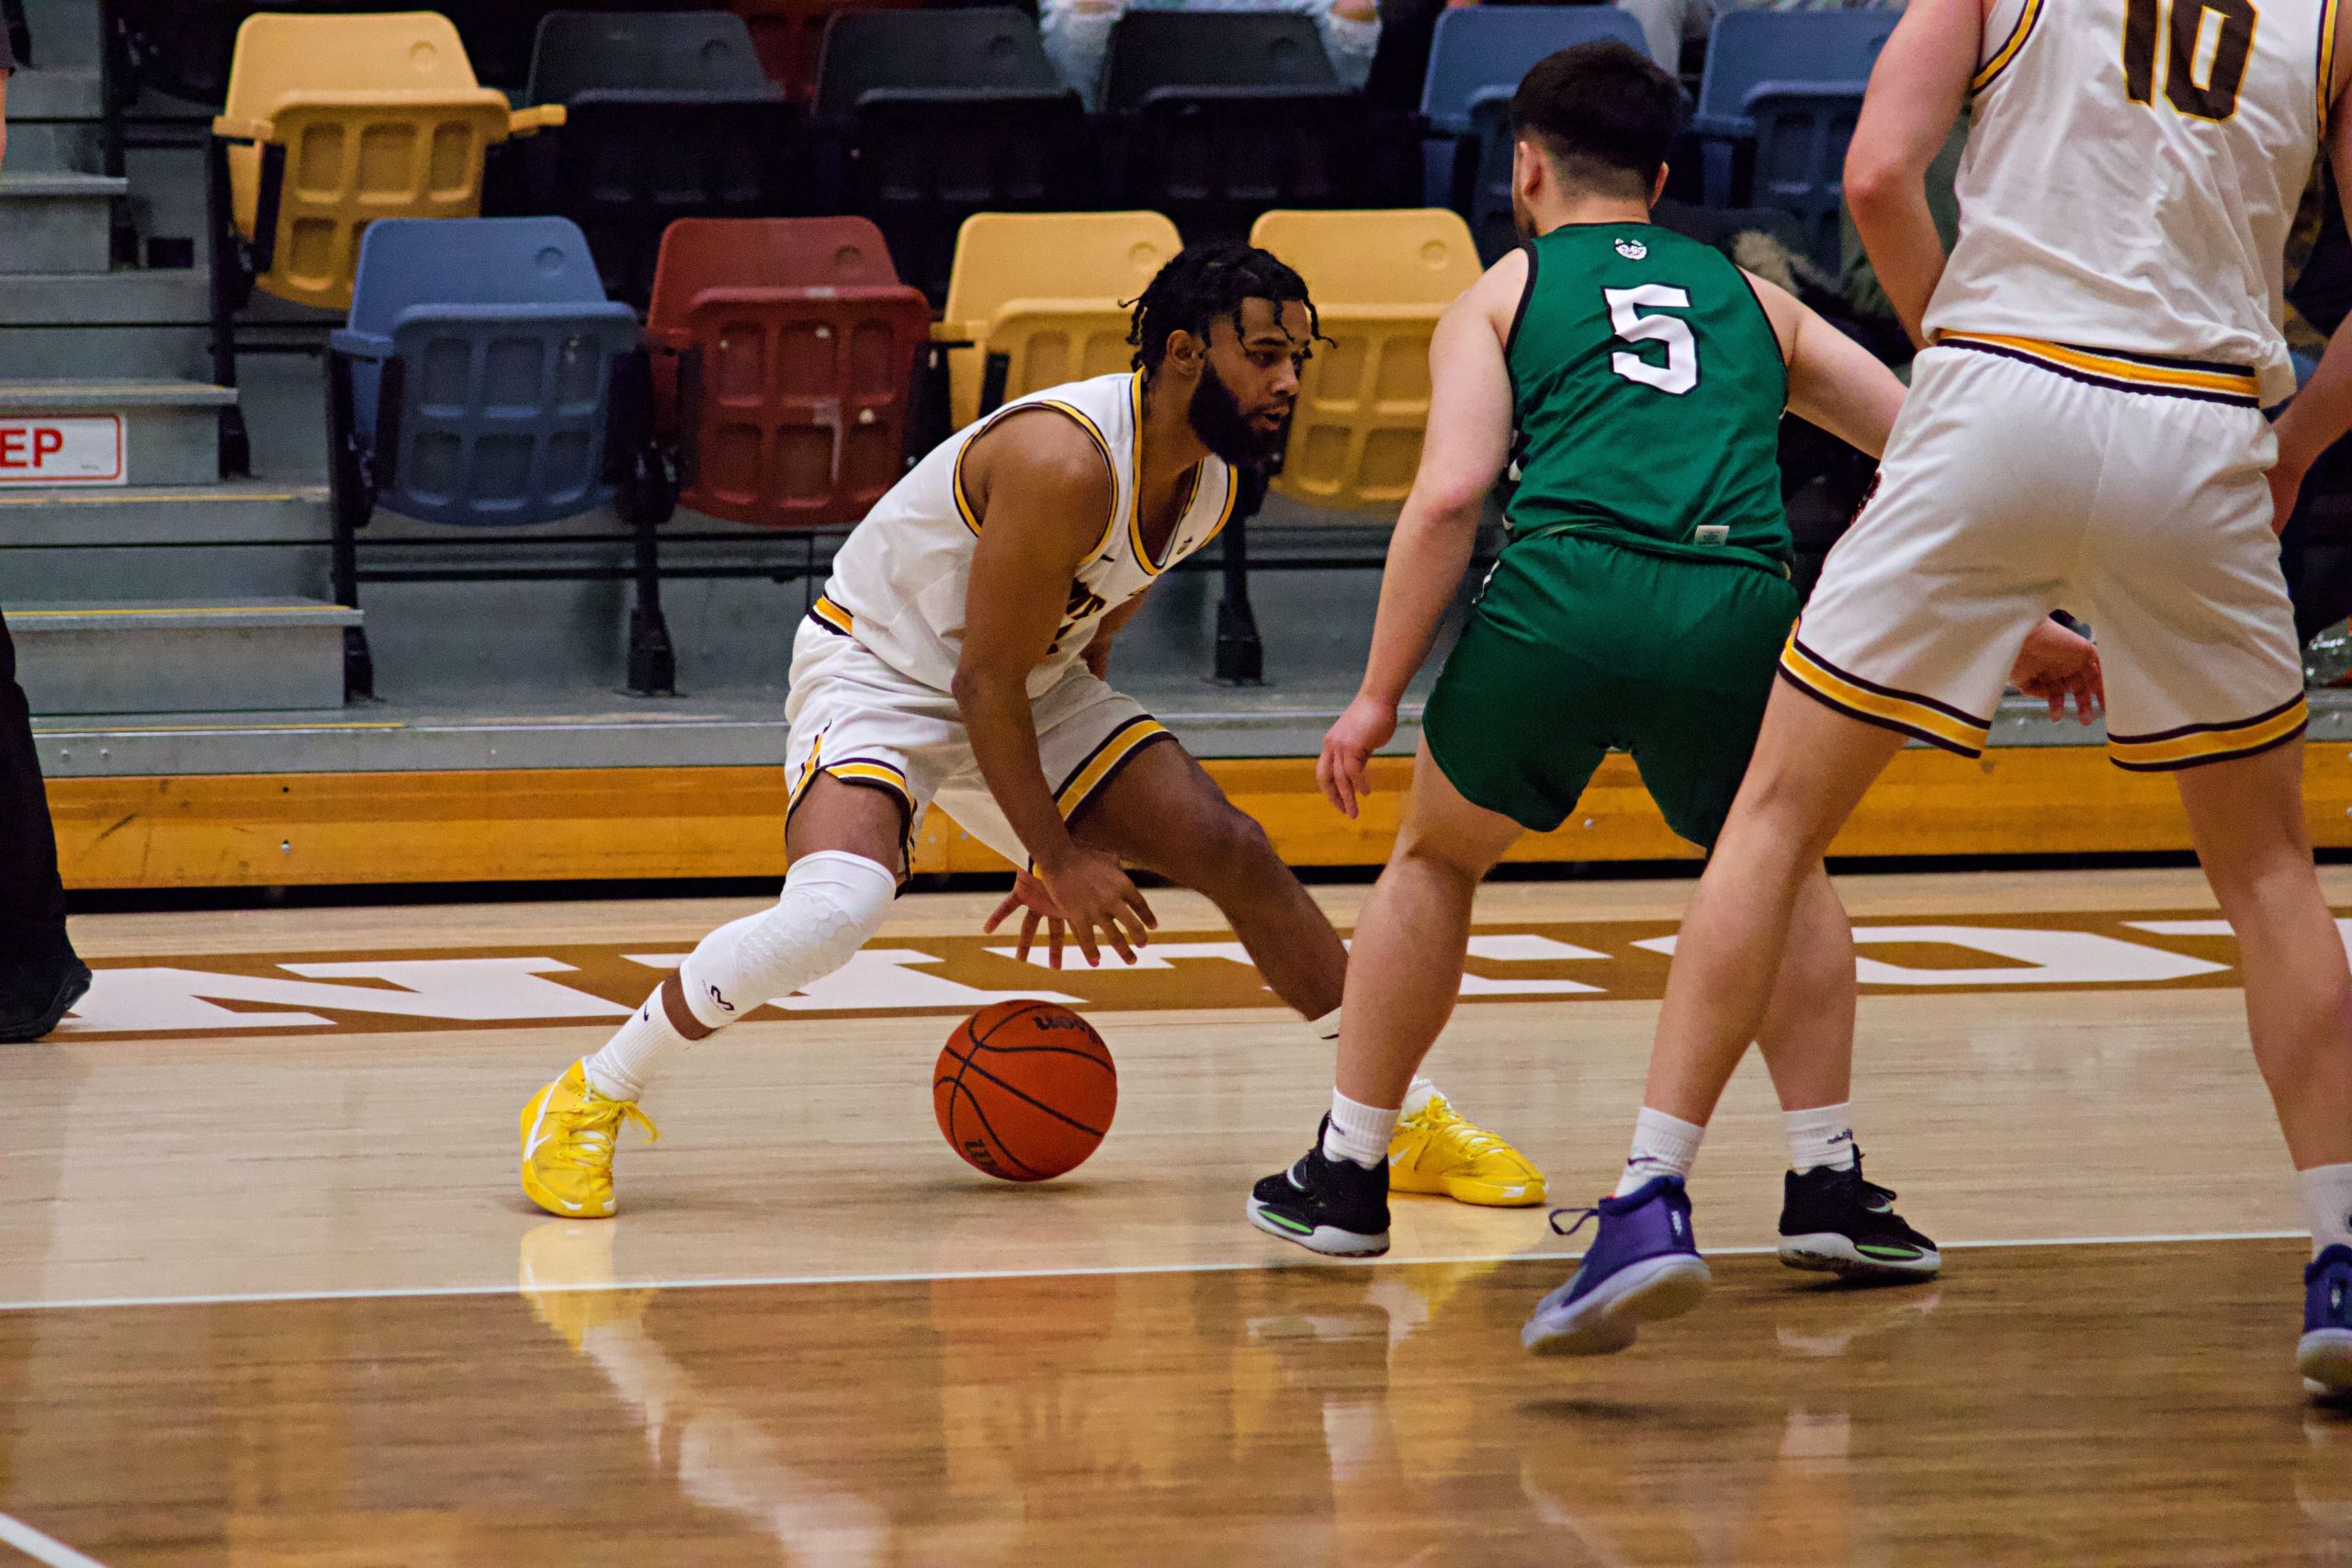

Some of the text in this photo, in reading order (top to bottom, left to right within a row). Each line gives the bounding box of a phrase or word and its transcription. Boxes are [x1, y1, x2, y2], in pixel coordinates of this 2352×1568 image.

[2121, 0, 2259, 123] 10
[1601, 283, 1700, 396] 5
[0, 428, 63, 468] EP
